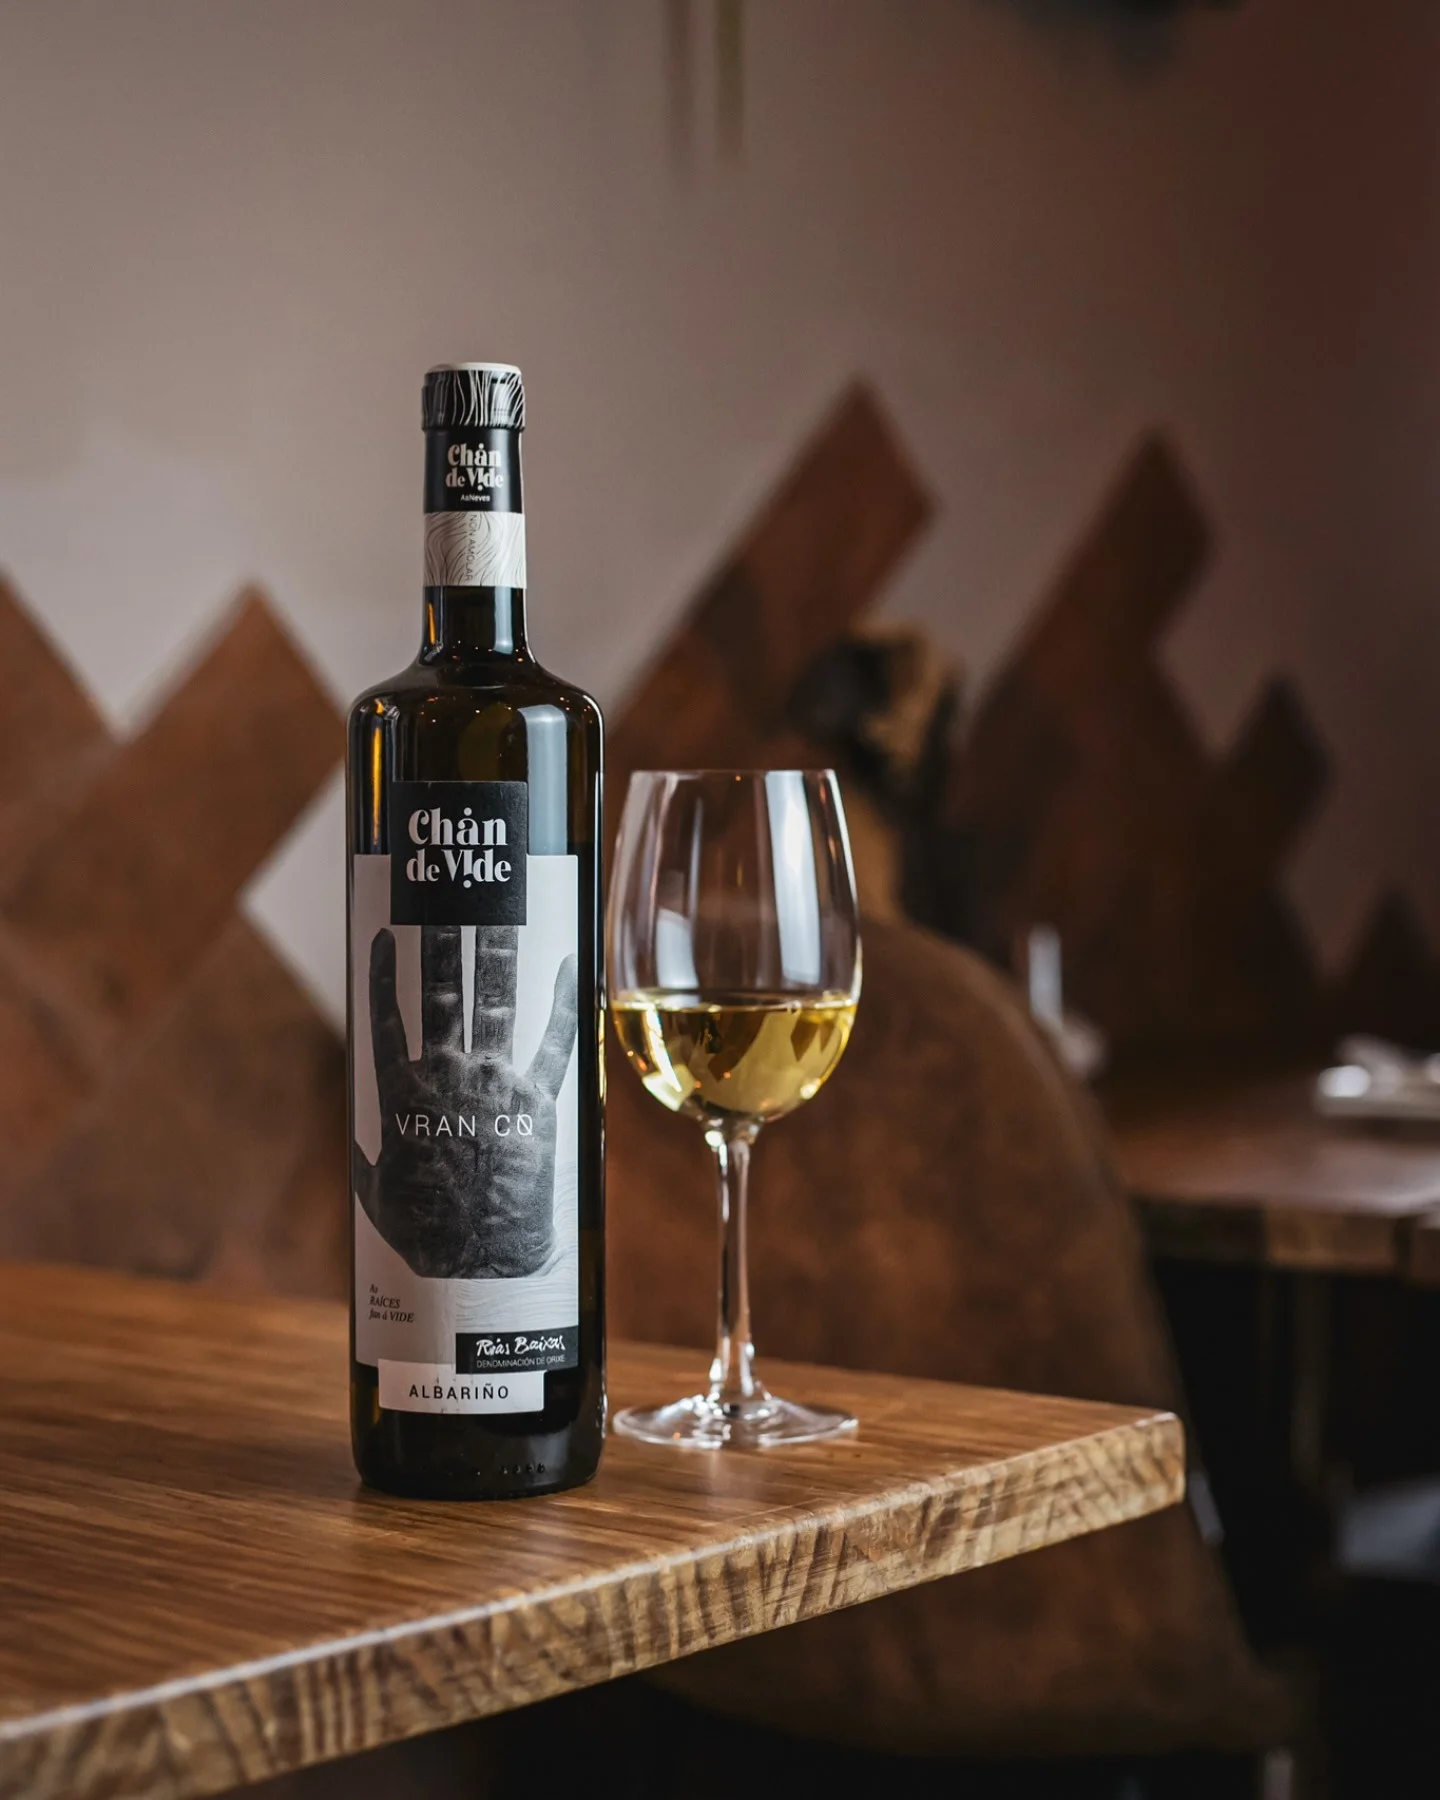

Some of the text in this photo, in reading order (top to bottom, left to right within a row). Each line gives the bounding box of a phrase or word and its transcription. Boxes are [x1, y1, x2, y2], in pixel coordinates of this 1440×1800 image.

[406, 848, 440, 882] de
[395, 1113, 476, 1137] VRAN
[390, 1311, 414, 1323] VIDE
[476, 1356, 536, 1369] DENOMINACIÓN
[536, 1357, 546, 1365] DE
[408, 1382, 509, 1400] ALBARIÑO
